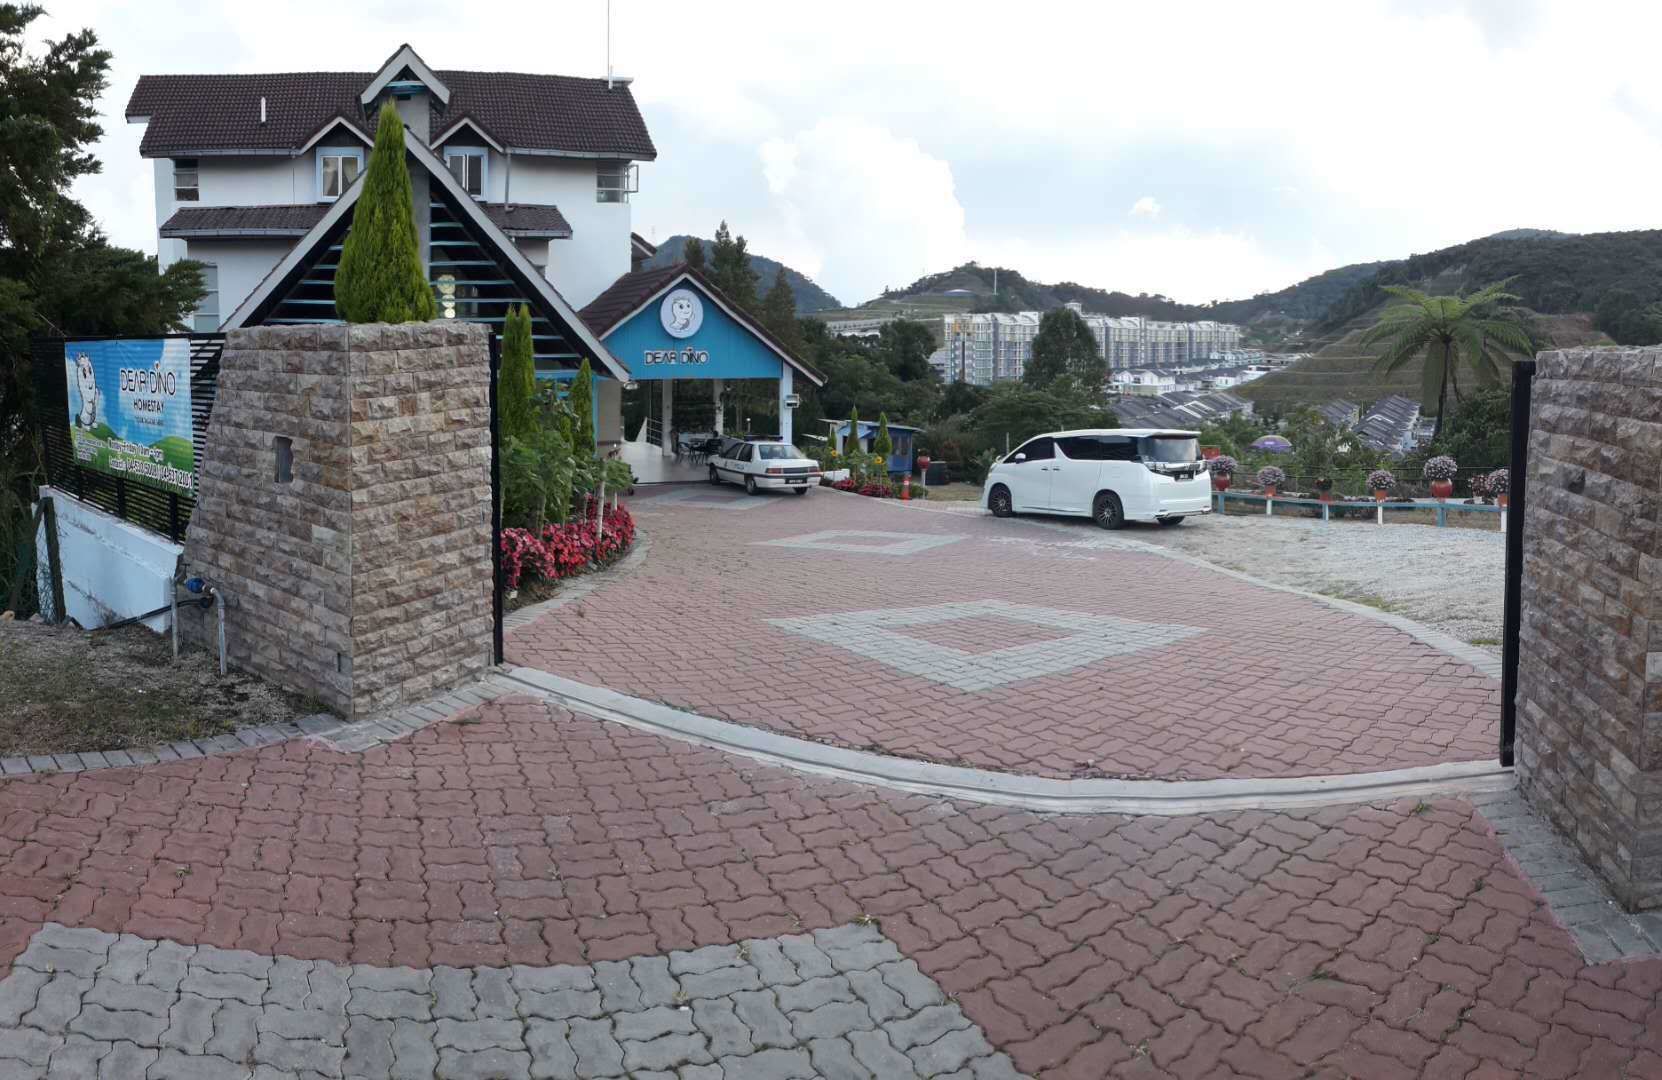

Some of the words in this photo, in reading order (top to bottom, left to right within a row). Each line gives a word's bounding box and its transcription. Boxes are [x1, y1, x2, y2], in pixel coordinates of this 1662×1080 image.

[644, 351, 677, 365] DEAR
[120, 368, 147, 393] DEAR
[133, 399, 165, 414] HOMESTAY
